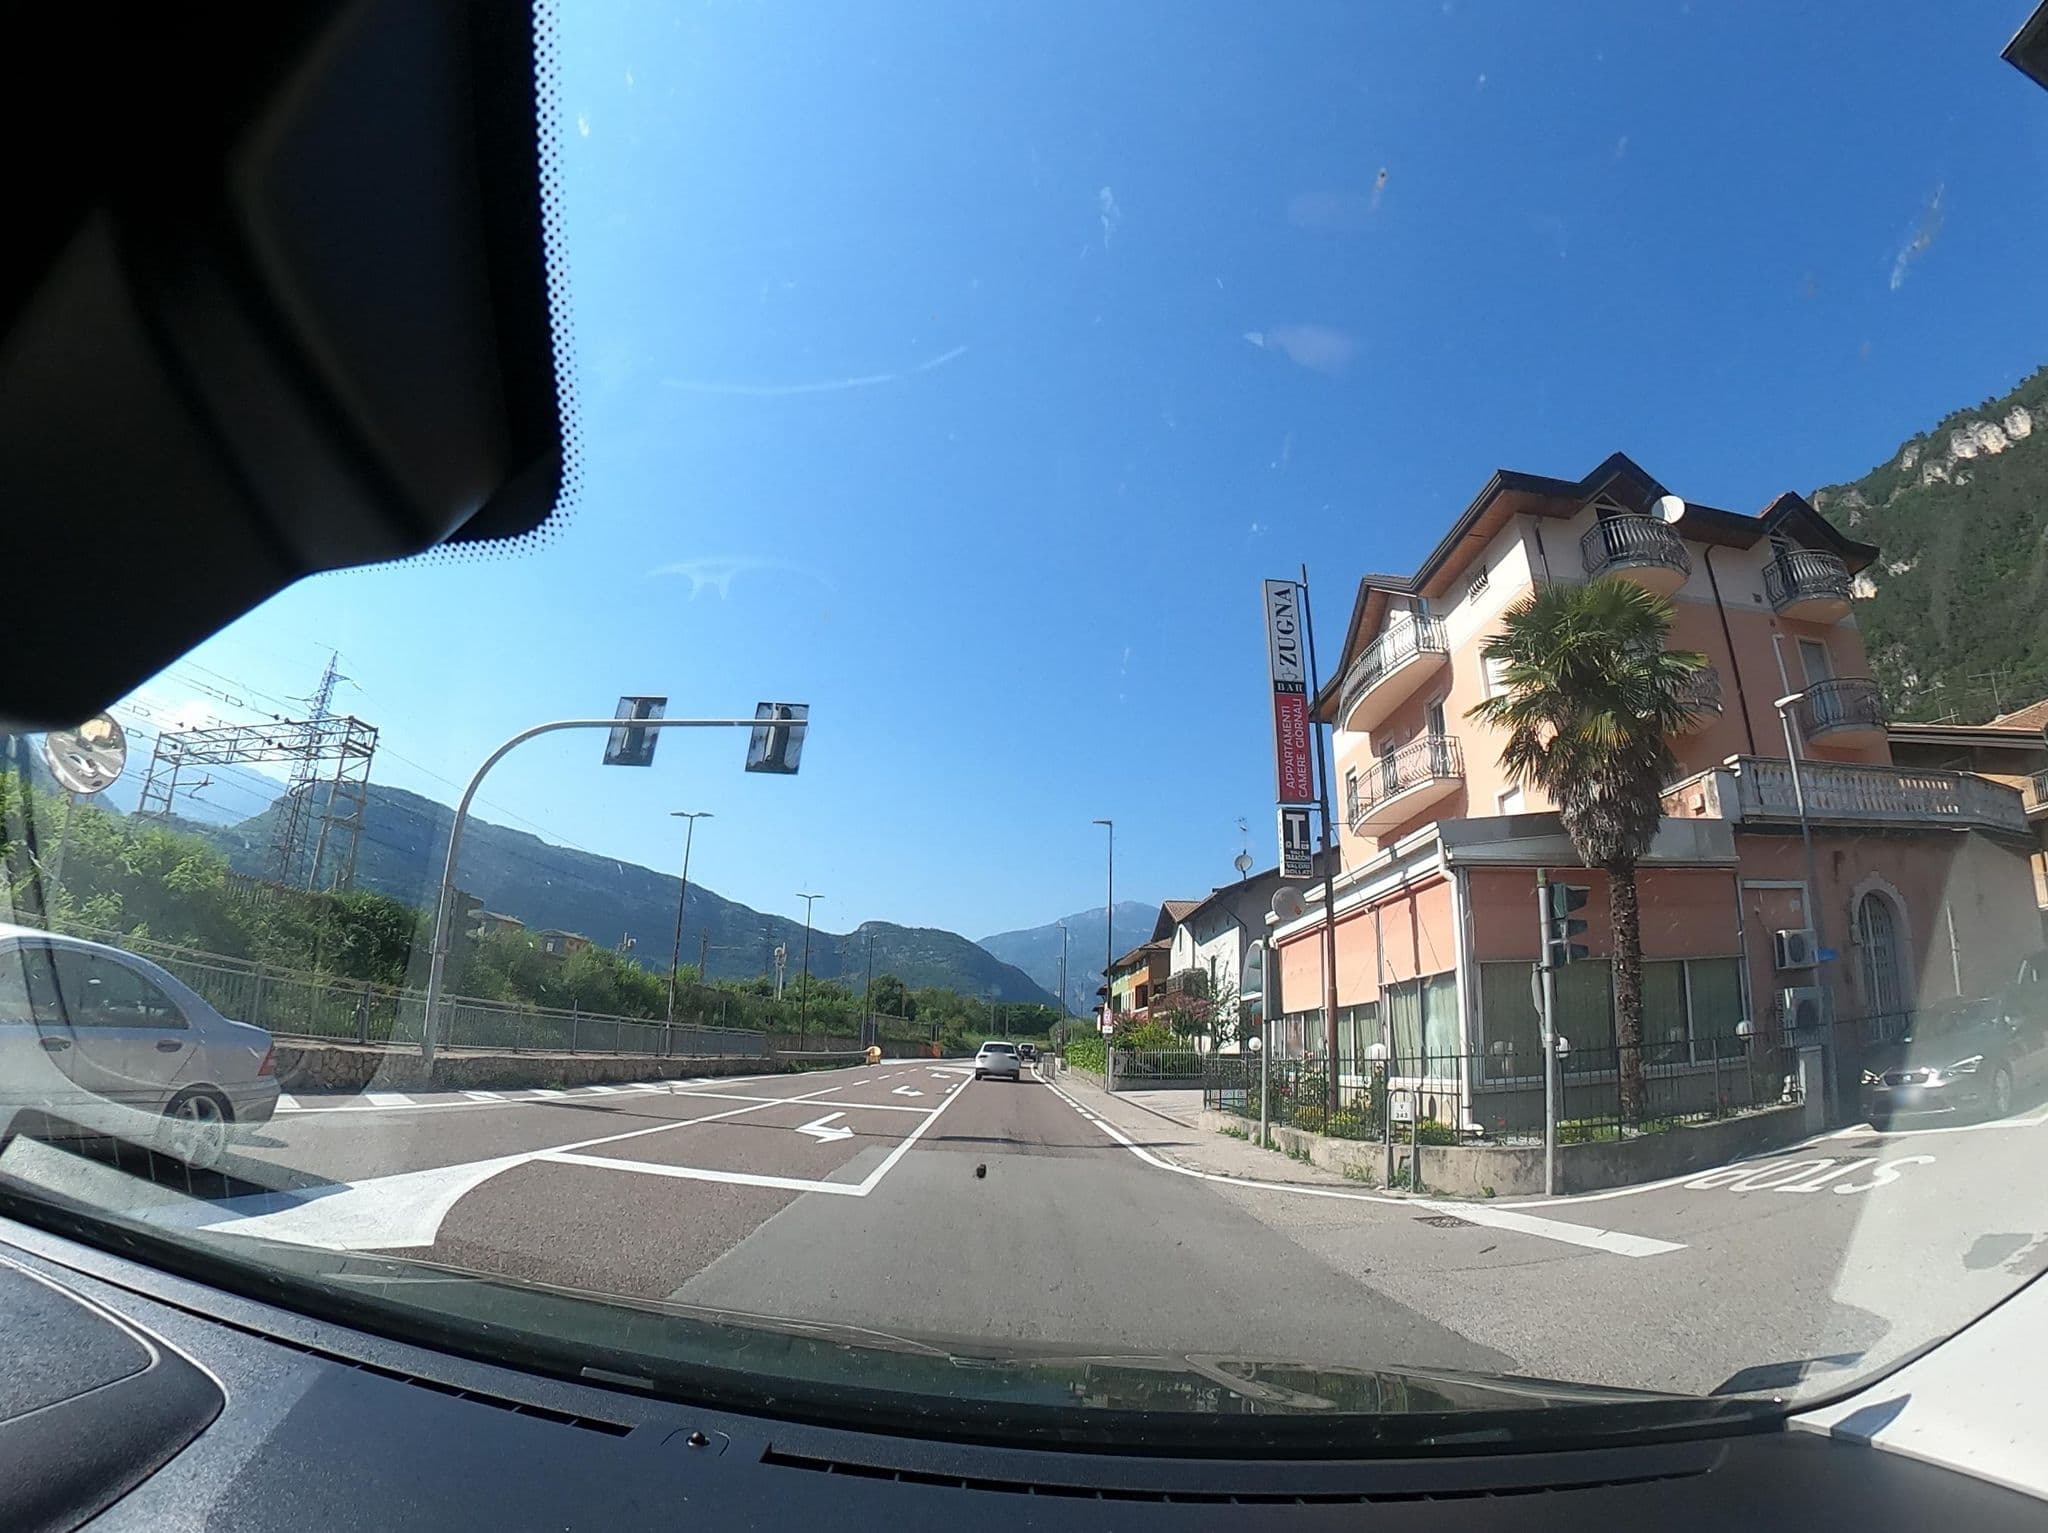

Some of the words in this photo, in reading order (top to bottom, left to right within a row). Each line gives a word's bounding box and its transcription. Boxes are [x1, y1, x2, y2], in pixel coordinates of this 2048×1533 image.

[1274, 588, 1298, 668] ZUGNA
[1276, 682, 1303, 692] BAR
[1292, 698, 1305, 748] GIORNALI
[1281, 705, 1296, 789] APPARTAMENTI
[1296, 753, 1309, 798] CAMERE
[1286, 814, 1306, 849] T
[1684, 1155, 1936, 1194] STOP
